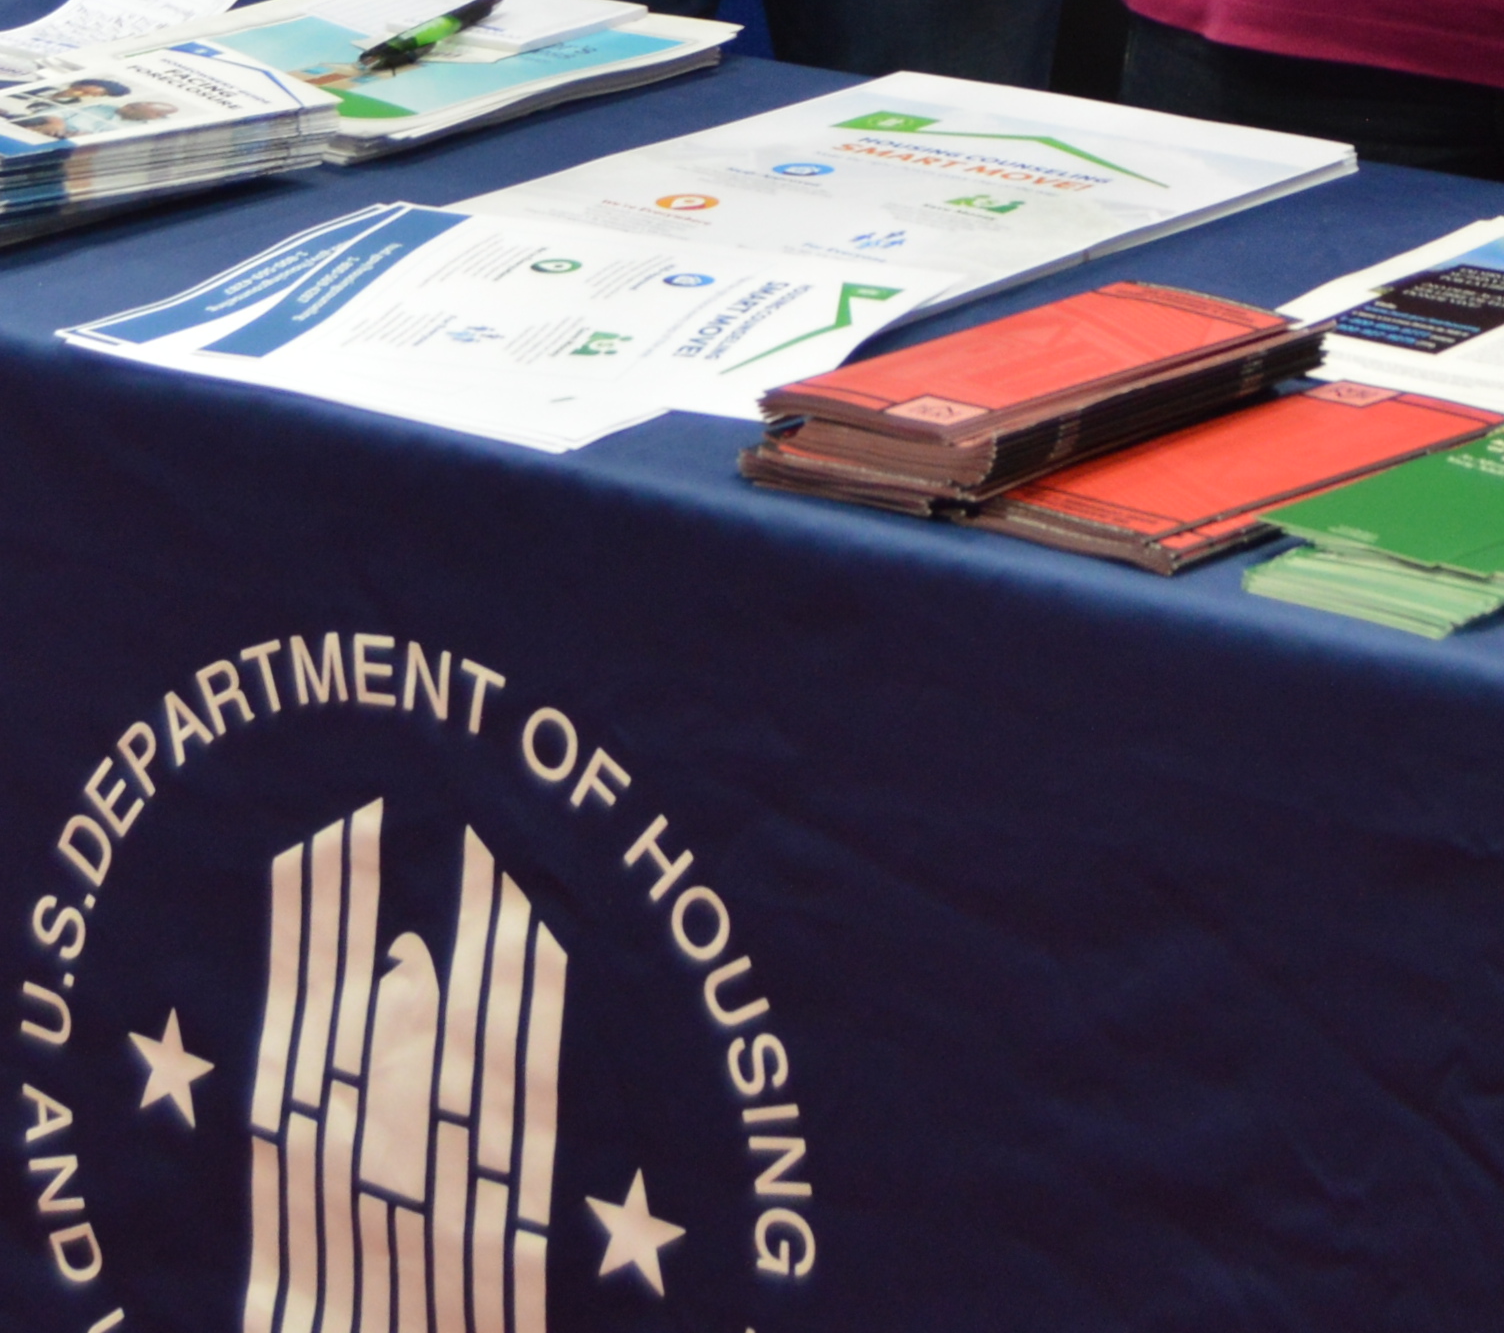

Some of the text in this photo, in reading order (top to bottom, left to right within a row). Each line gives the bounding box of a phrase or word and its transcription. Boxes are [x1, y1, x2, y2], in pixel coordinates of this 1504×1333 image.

[833, 142, 1092, 193] SMART MOVE!
[857, 136, 1112, 185] HOUSING COUNSELING
[521, 706, 632, 810] OF
[623, 813, 817, 1281] HOUSING
[20, 1081, 105, 1283] AND
